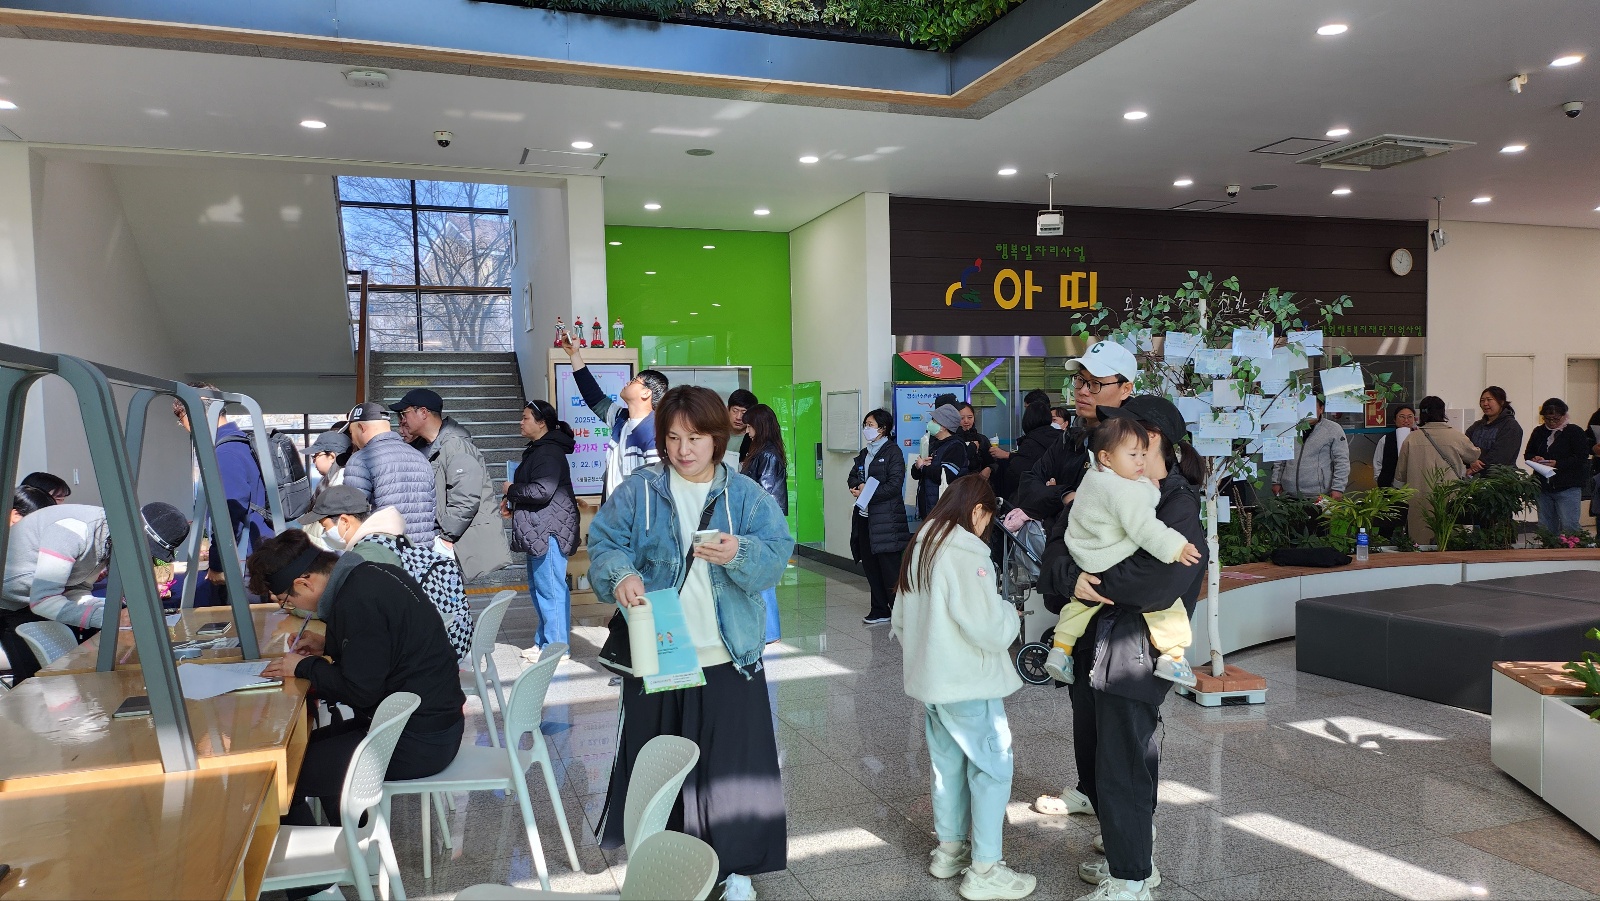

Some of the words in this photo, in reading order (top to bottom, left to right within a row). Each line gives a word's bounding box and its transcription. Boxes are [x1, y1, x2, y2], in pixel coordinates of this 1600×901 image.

[1091, 342, 1104, 353] C
[353, 408, 363, 417] 10
[574, 416, 596, 424] 2025년
